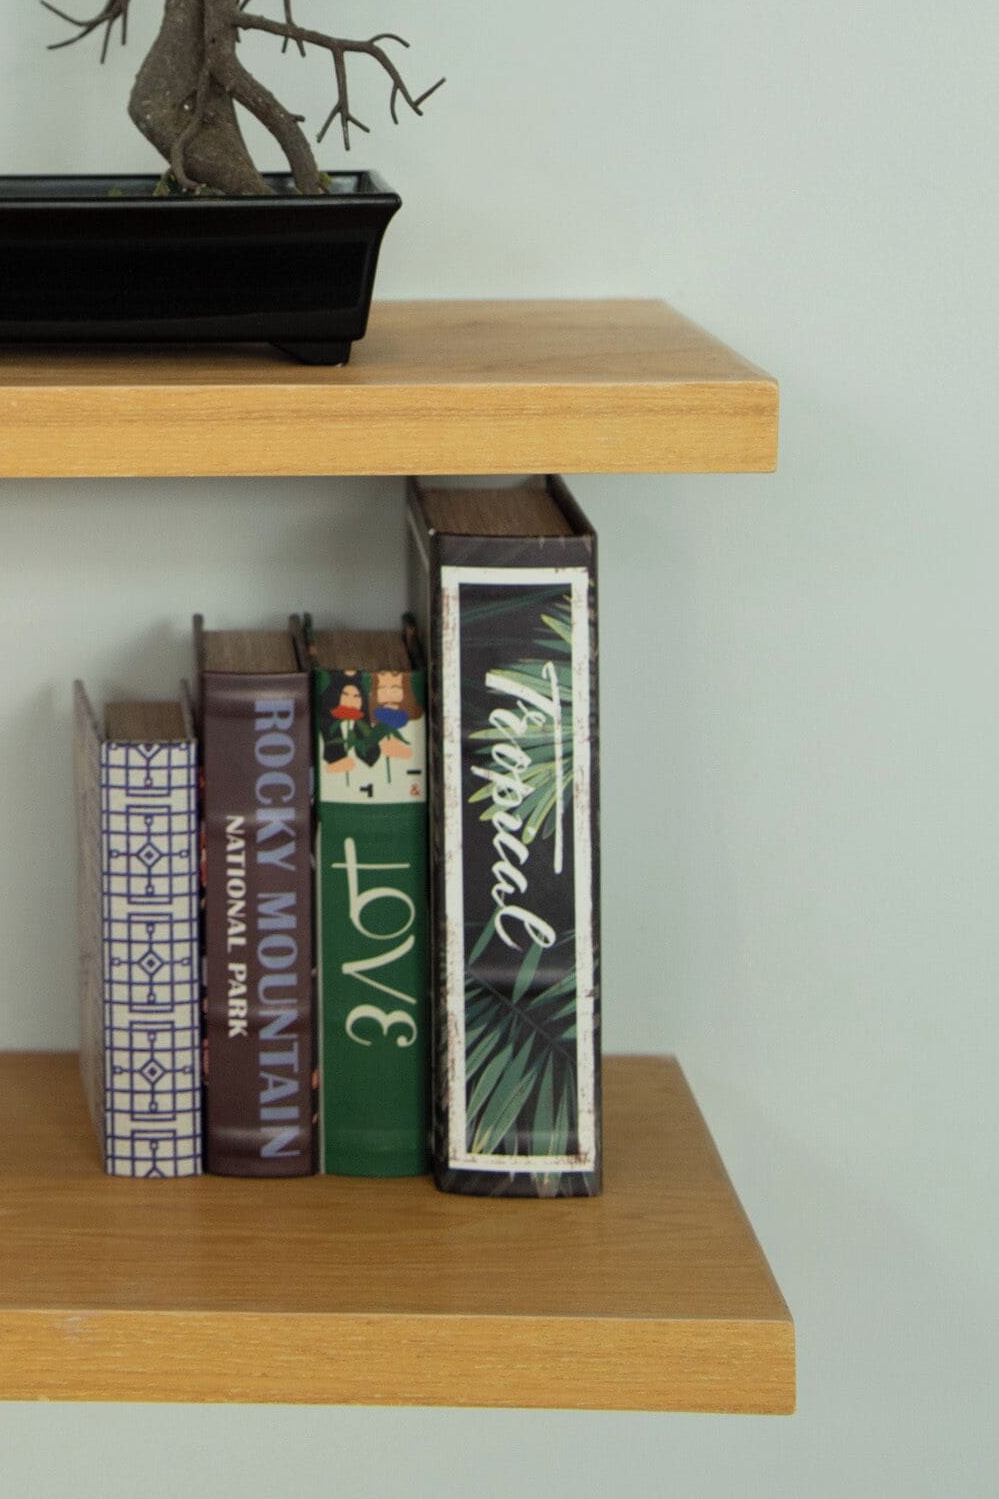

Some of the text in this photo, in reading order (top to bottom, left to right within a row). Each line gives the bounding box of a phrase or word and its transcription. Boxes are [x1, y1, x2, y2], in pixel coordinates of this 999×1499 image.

[226, 815, 248, 1038] NATIONAL PARK
[254, 698, 300, 1160] ROCKY MOUNTAIN
[471, 661, 563, 951] Tropical
